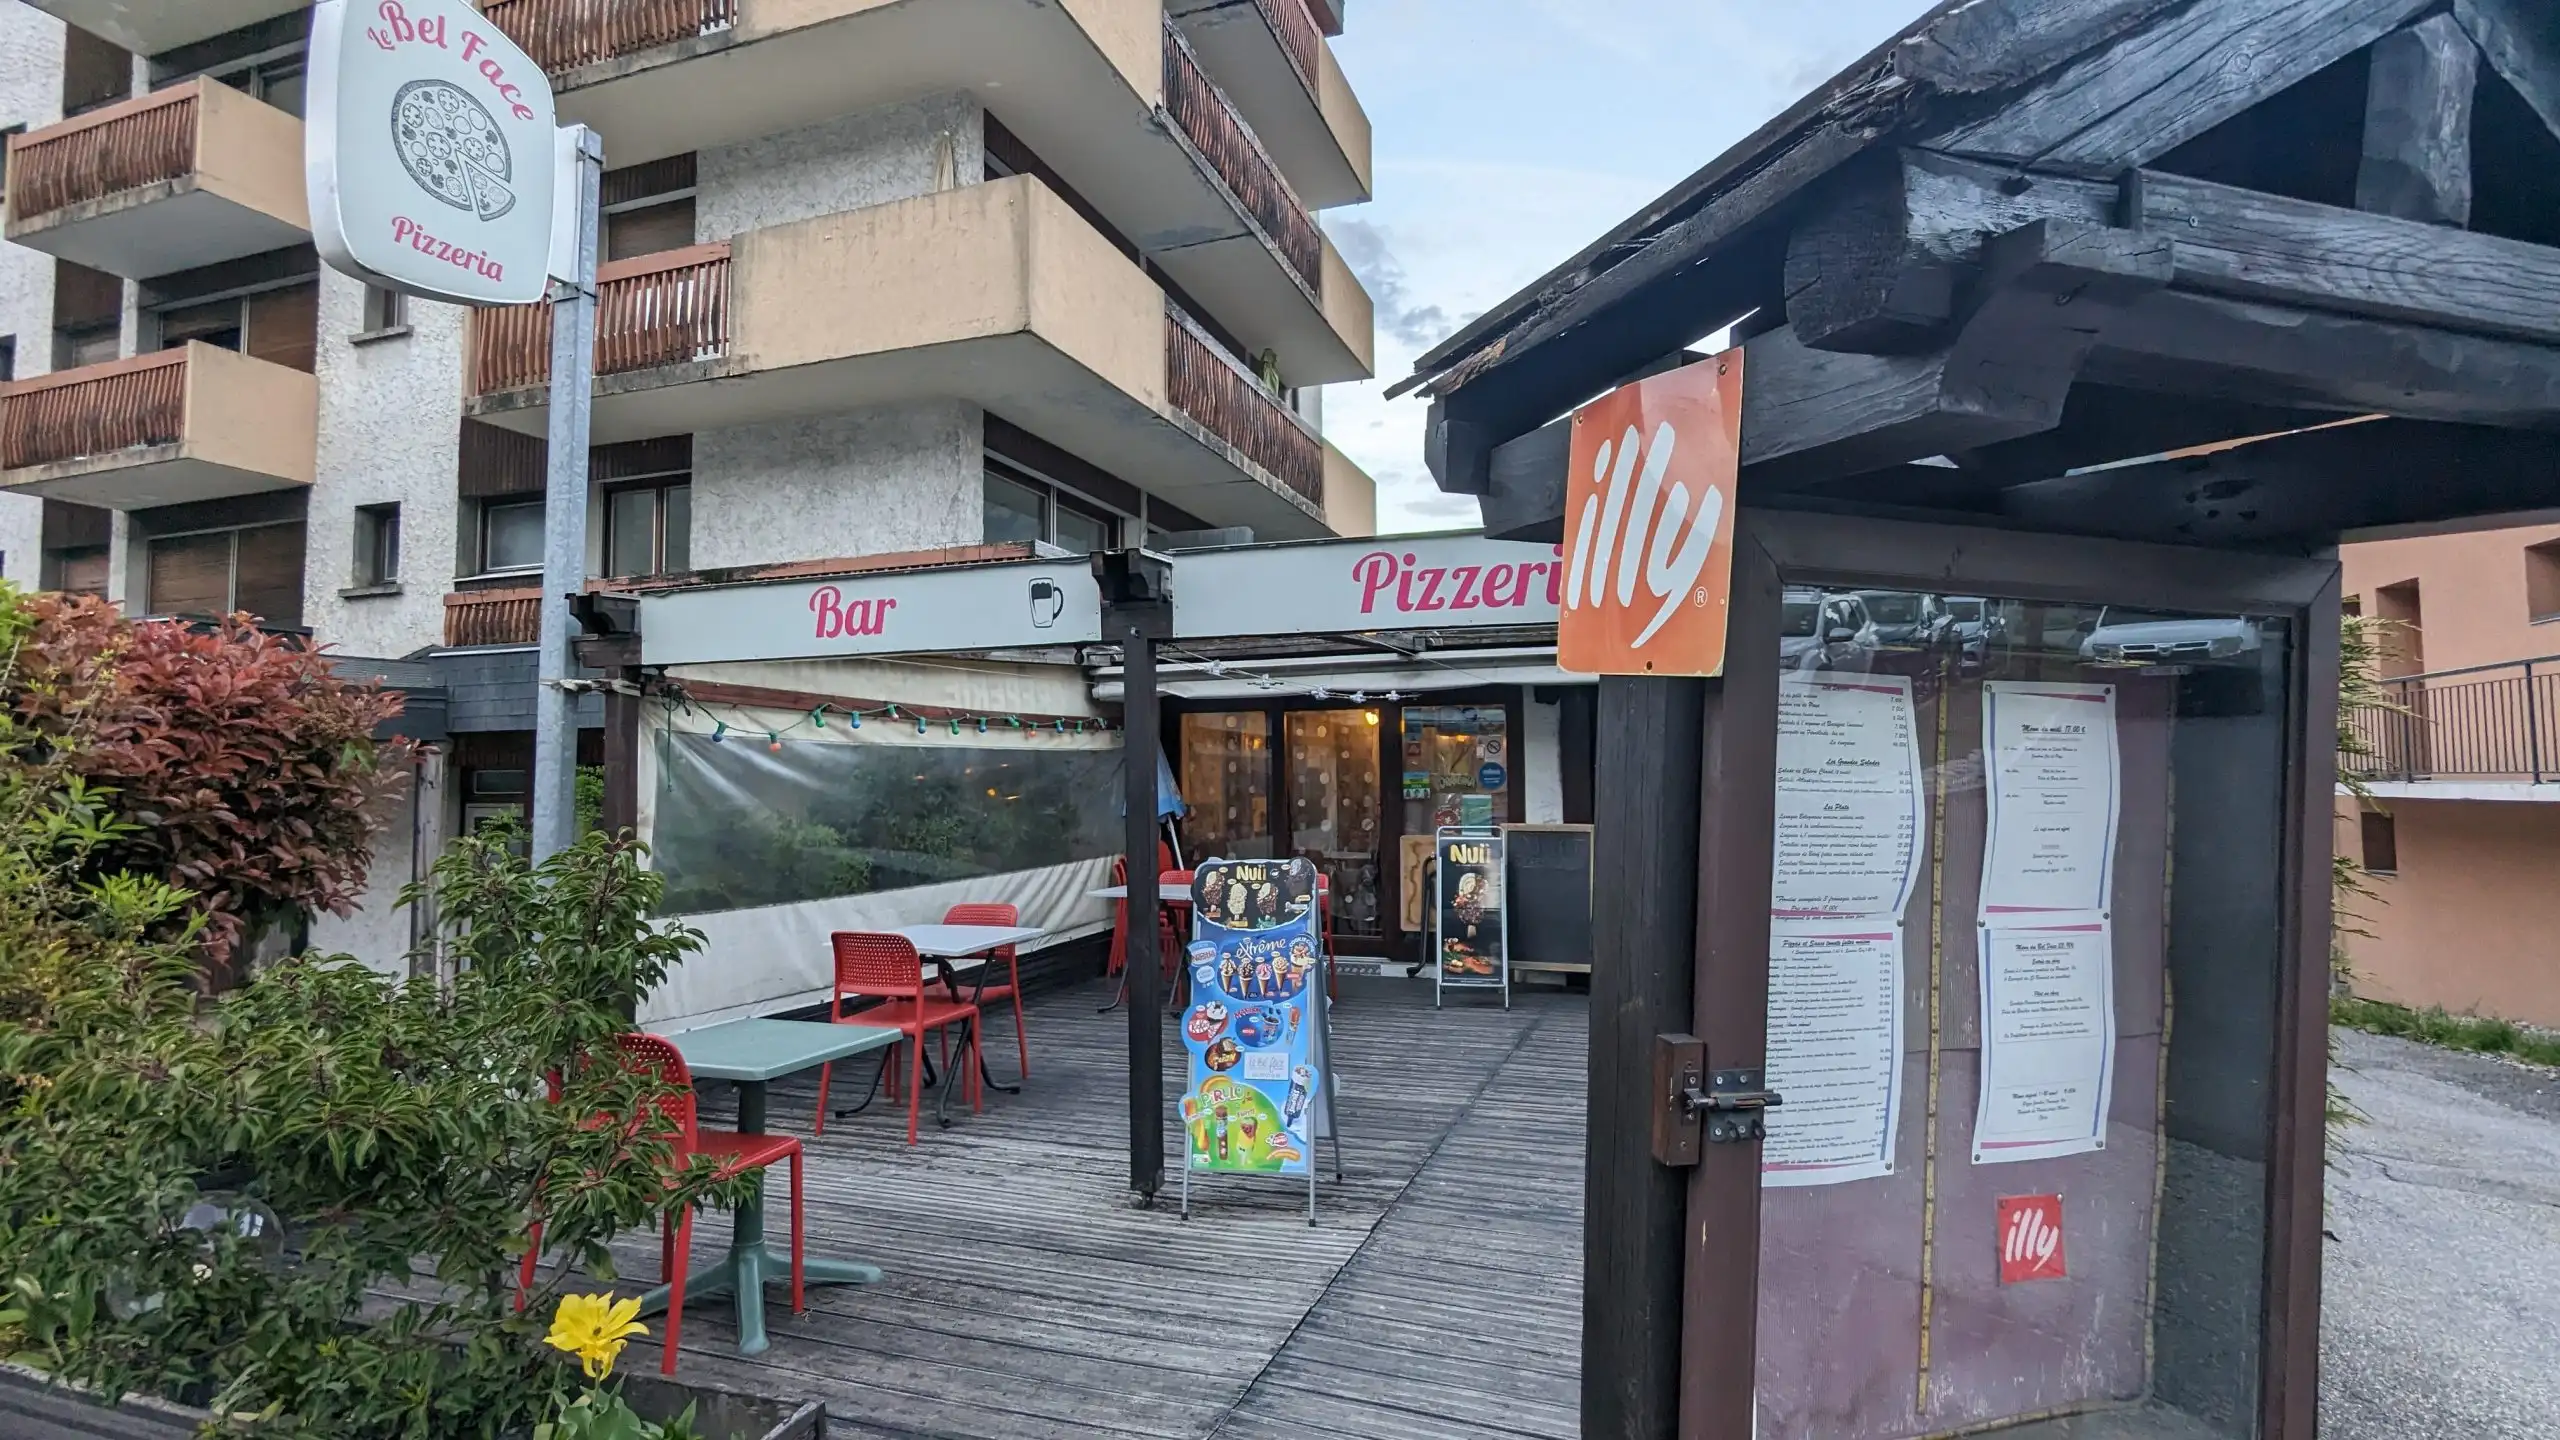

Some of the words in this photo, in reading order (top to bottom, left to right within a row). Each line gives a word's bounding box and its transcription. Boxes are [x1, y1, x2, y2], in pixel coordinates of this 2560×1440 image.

[367, 25, 396, 51] Le
[379, 0, 448, 49] Bel
[461, 30, 535, 121] Face
[391, 215, 503, 283] Pizzeria
[1568, 420, 1723, 649] illy
[808, 585, 898, 639] Bar
[1351, 543, 1563, 615] Pizzeri
